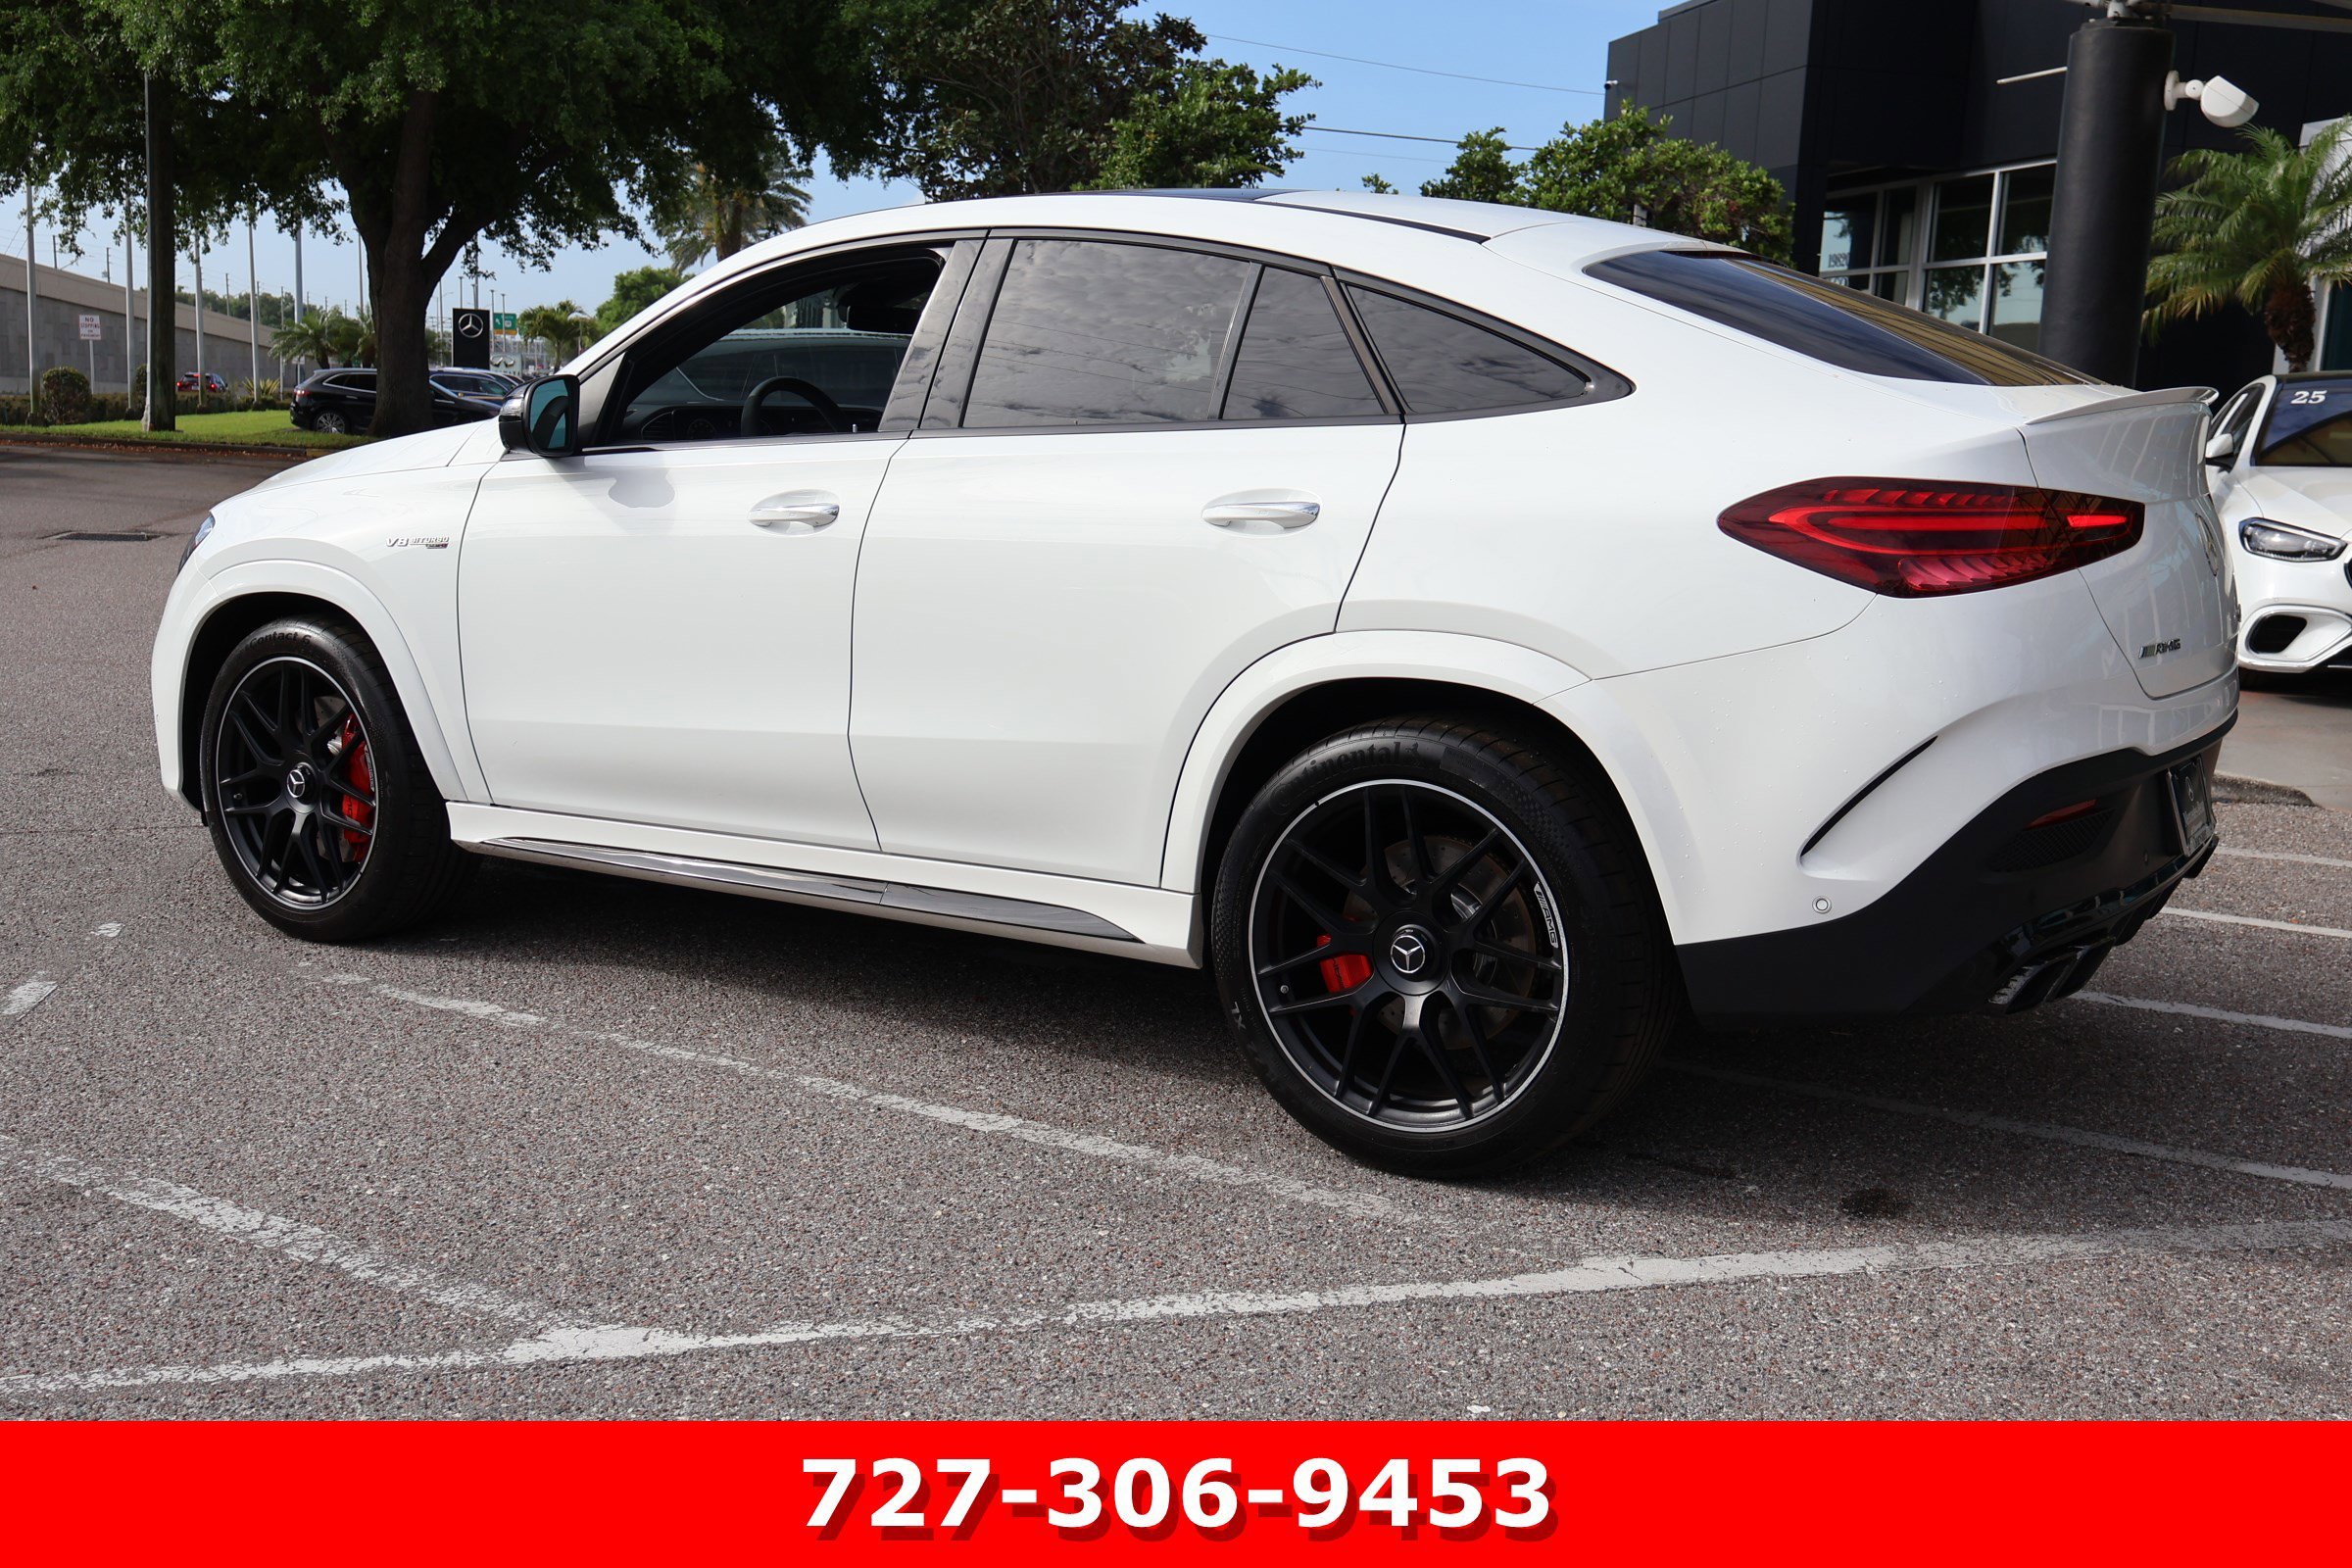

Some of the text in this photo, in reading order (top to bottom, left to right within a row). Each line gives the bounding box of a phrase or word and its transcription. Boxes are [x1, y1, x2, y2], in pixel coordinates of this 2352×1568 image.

[2290, 390, 2328, 405] 25
[386, 537, 410, 547] V8
[1542, 906, 1557, 944] AMG
